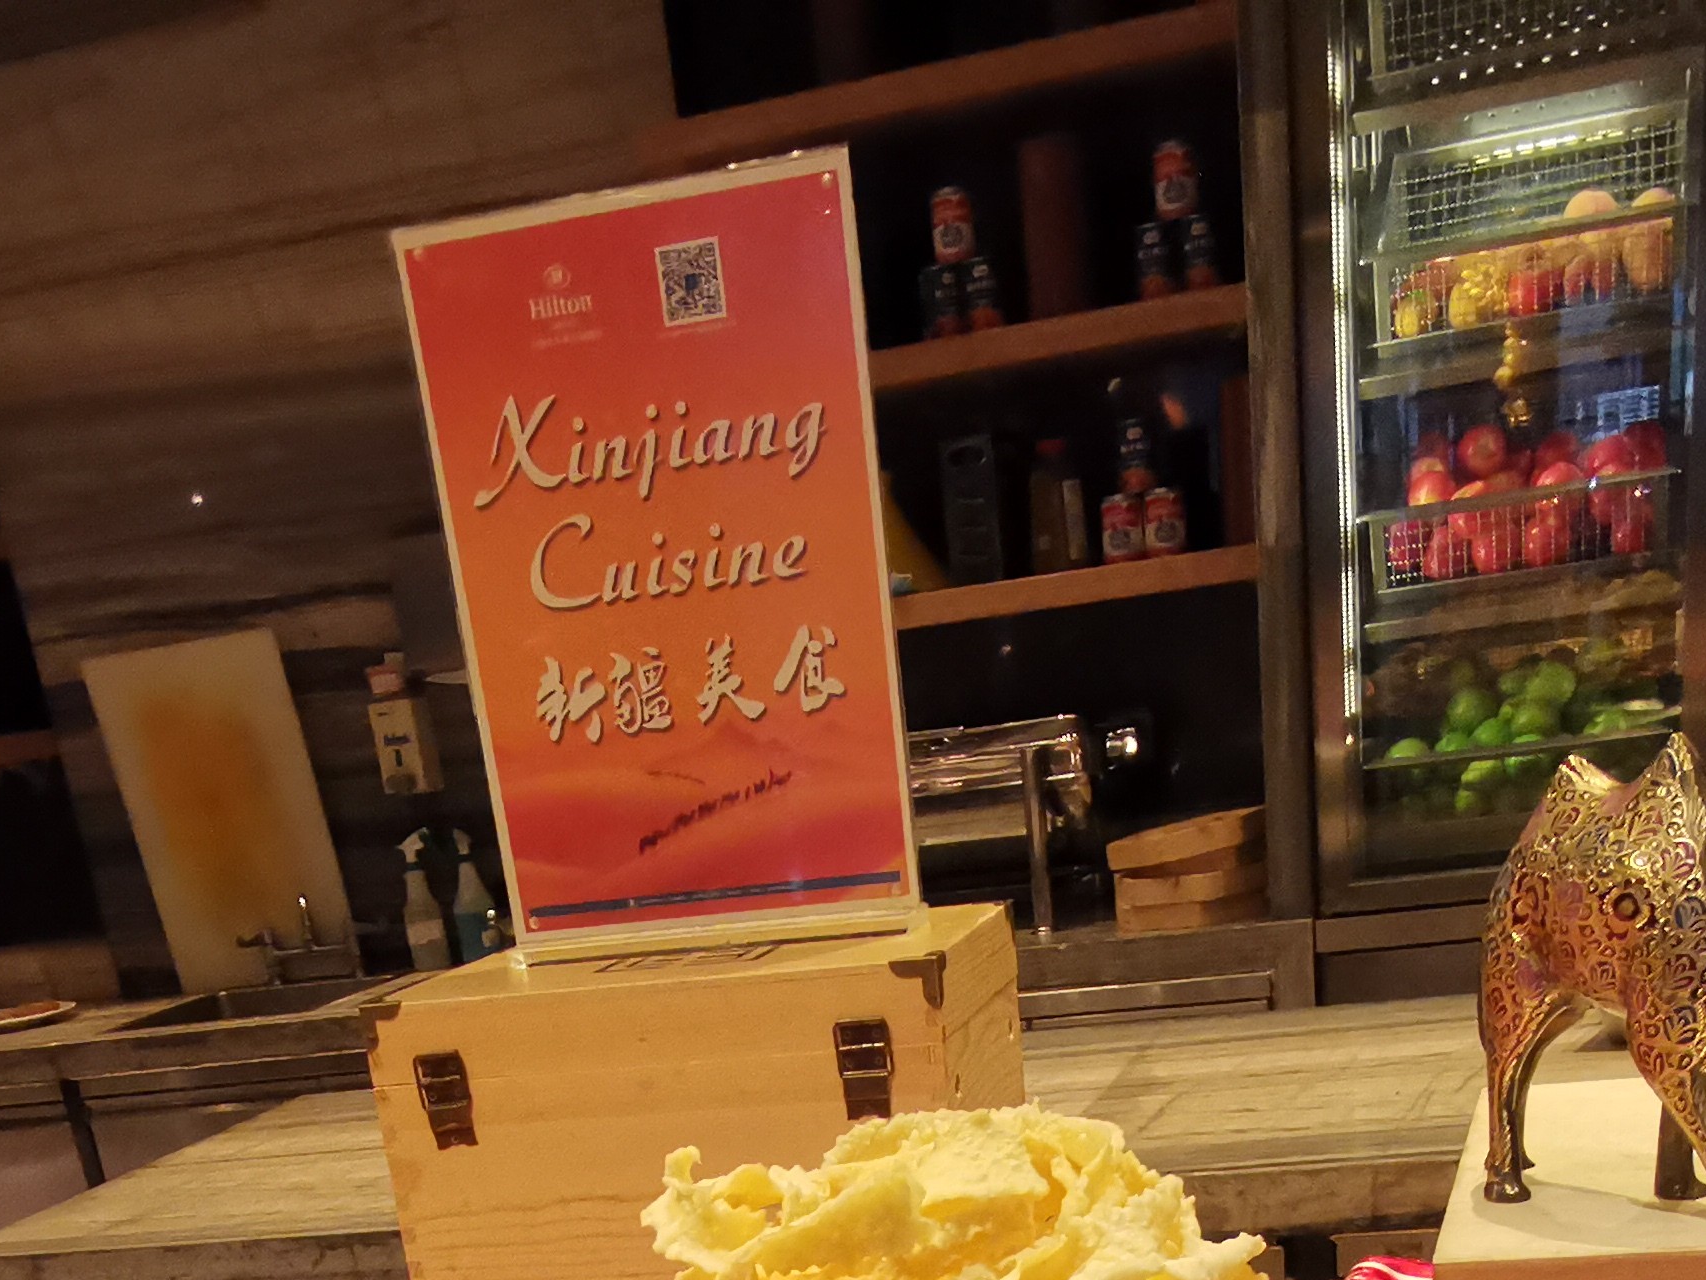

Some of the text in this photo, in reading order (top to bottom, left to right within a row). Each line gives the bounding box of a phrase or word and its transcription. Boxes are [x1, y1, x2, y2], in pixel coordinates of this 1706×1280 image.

[529, 294, 592, 320] Hilton
[473, 394, 825, 508] Xinjiang
[530, 513, 808, 610] Cuisine
[536, 625, 846, 743] 新疆美食
